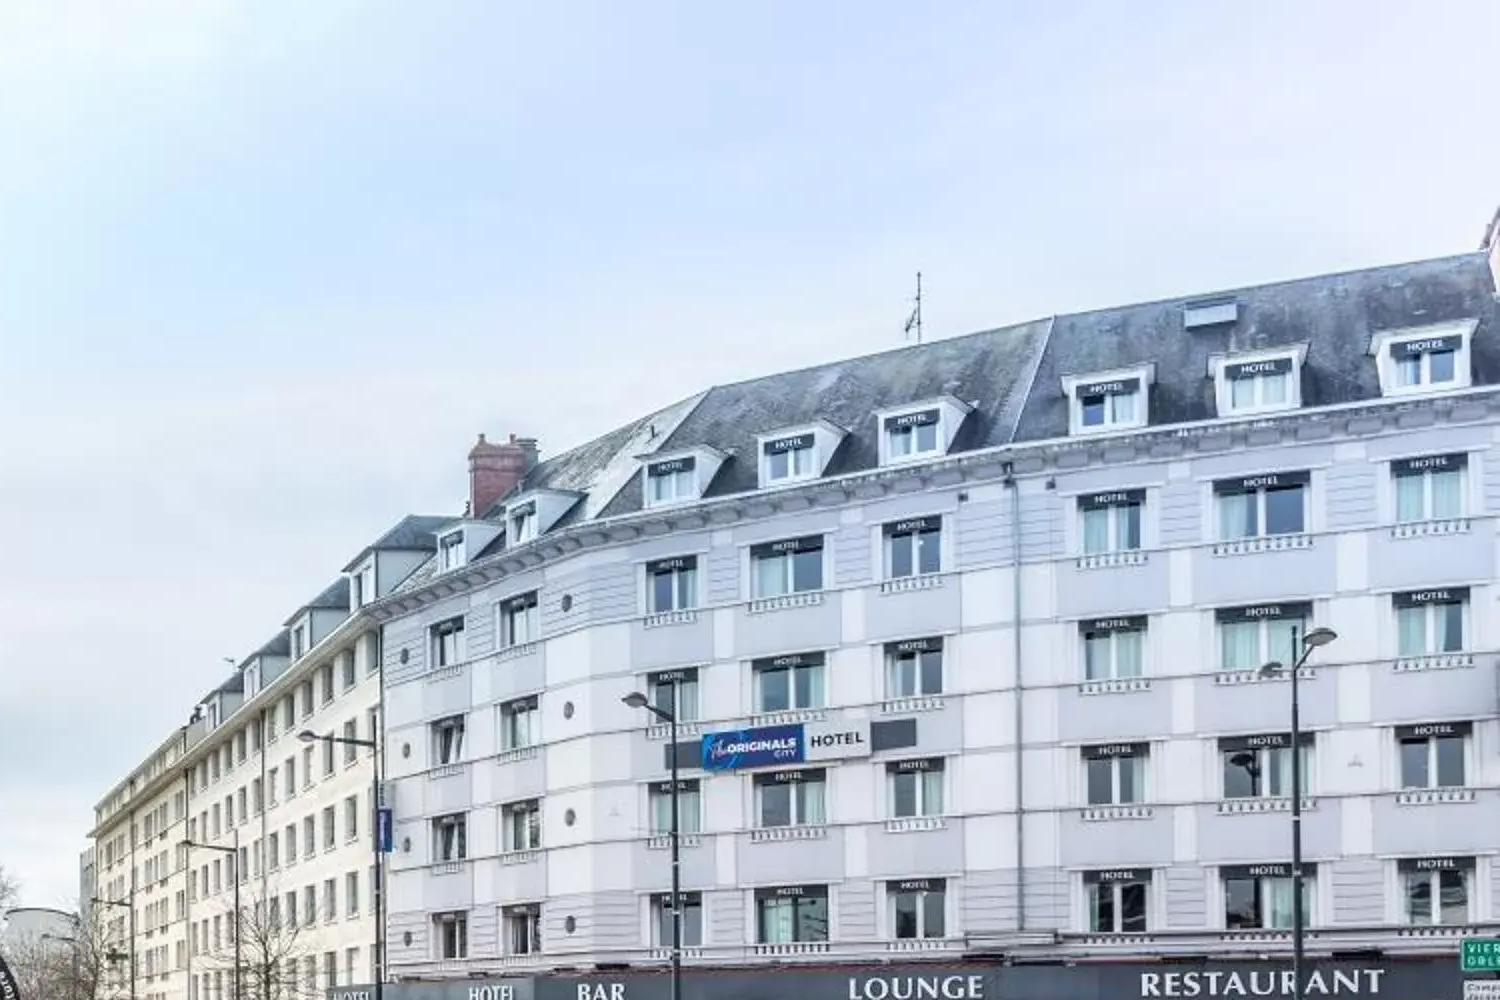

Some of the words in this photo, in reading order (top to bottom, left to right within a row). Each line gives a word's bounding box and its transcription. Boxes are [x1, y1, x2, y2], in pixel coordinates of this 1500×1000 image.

[1406, 341, 1444, 352] HOTEL
[1241, 362, 1276, 373] HOTEL
[1090, 382, 1124, 393] HOTEL
[898, 415, 926, 425] HOTEL
[776, 438, 803, 449] HOTEL
[1410, 457, 1447, 467] HOTEL
[1243, 476, 1279, 487] HOTEL
[1094, 493, 1128, 503] HOTEL
[1412, 592, 1449, 601] HOTEL
[1246, 607, 1280, 615] HOTEL
[1096, 620, 1128, 628] HOTEL
[1415, 725, 1453, 734] HOTEL
[811, 732, 865, 748] HOTEL
[1248, 736, 1283, 745] HOTEL
[727, 738, 797, 753] ORIGINALS
[1099, 745, 1132, 754] HOTEL
[773, 749, 796, 758] CITY
[1418, 859, 1455, 868] HOTEL
[1250, 865, 1285, 874] HOTEL
[1100, 871, 1134, 880] HOTEL
[849, 975, 983, 1000] LOUNGE
[1141, 969, 1385, 997] RESTAURANT
